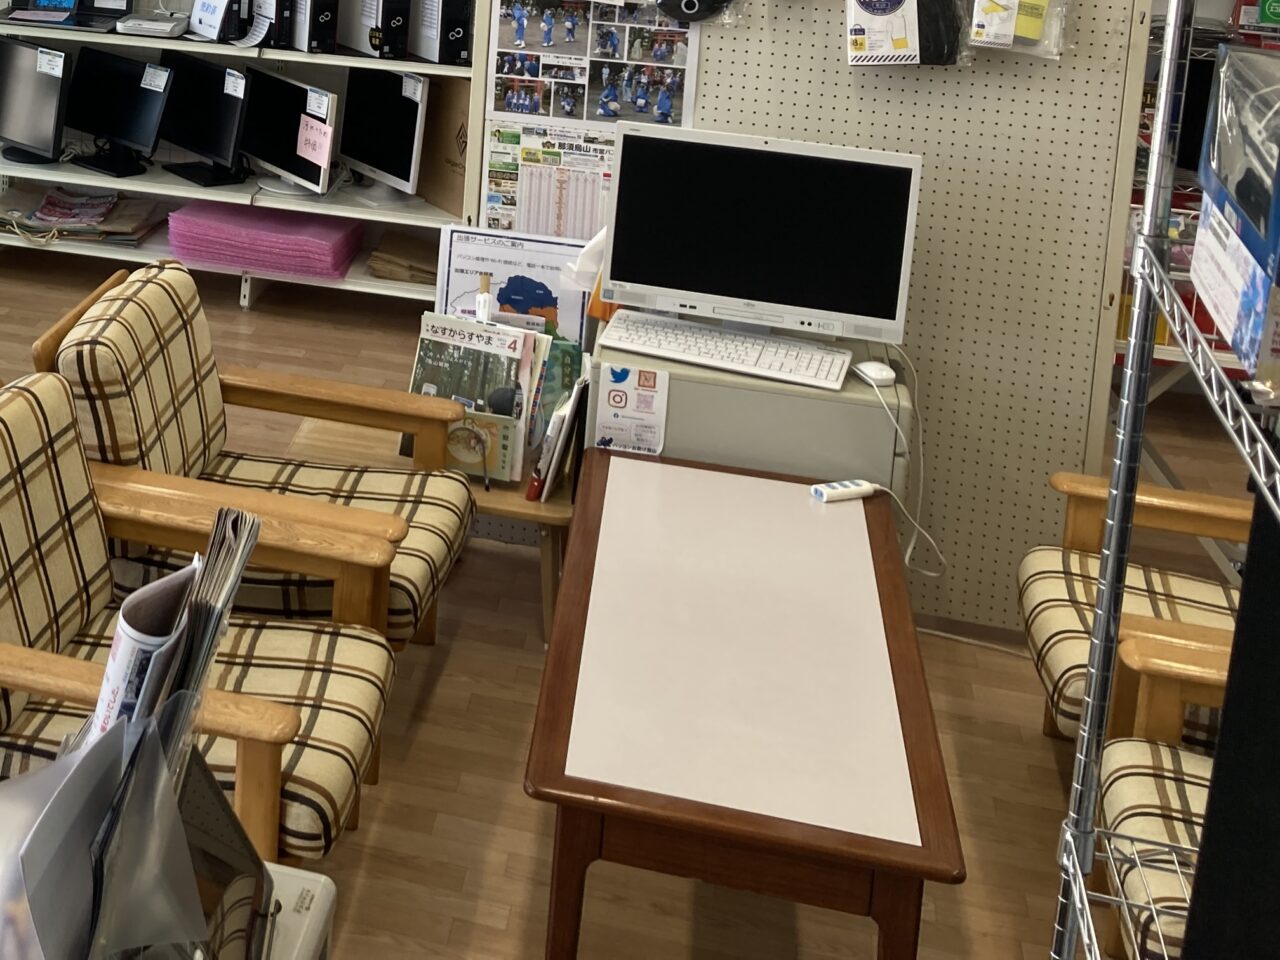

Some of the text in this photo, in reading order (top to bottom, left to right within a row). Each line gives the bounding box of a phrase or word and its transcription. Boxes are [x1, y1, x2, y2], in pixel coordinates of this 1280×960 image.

[456, 234, 525, 249] 出張サービスのご案内
[430, 324, 493, 346] なすからすやま
[507, 339, 518, 353] 4
